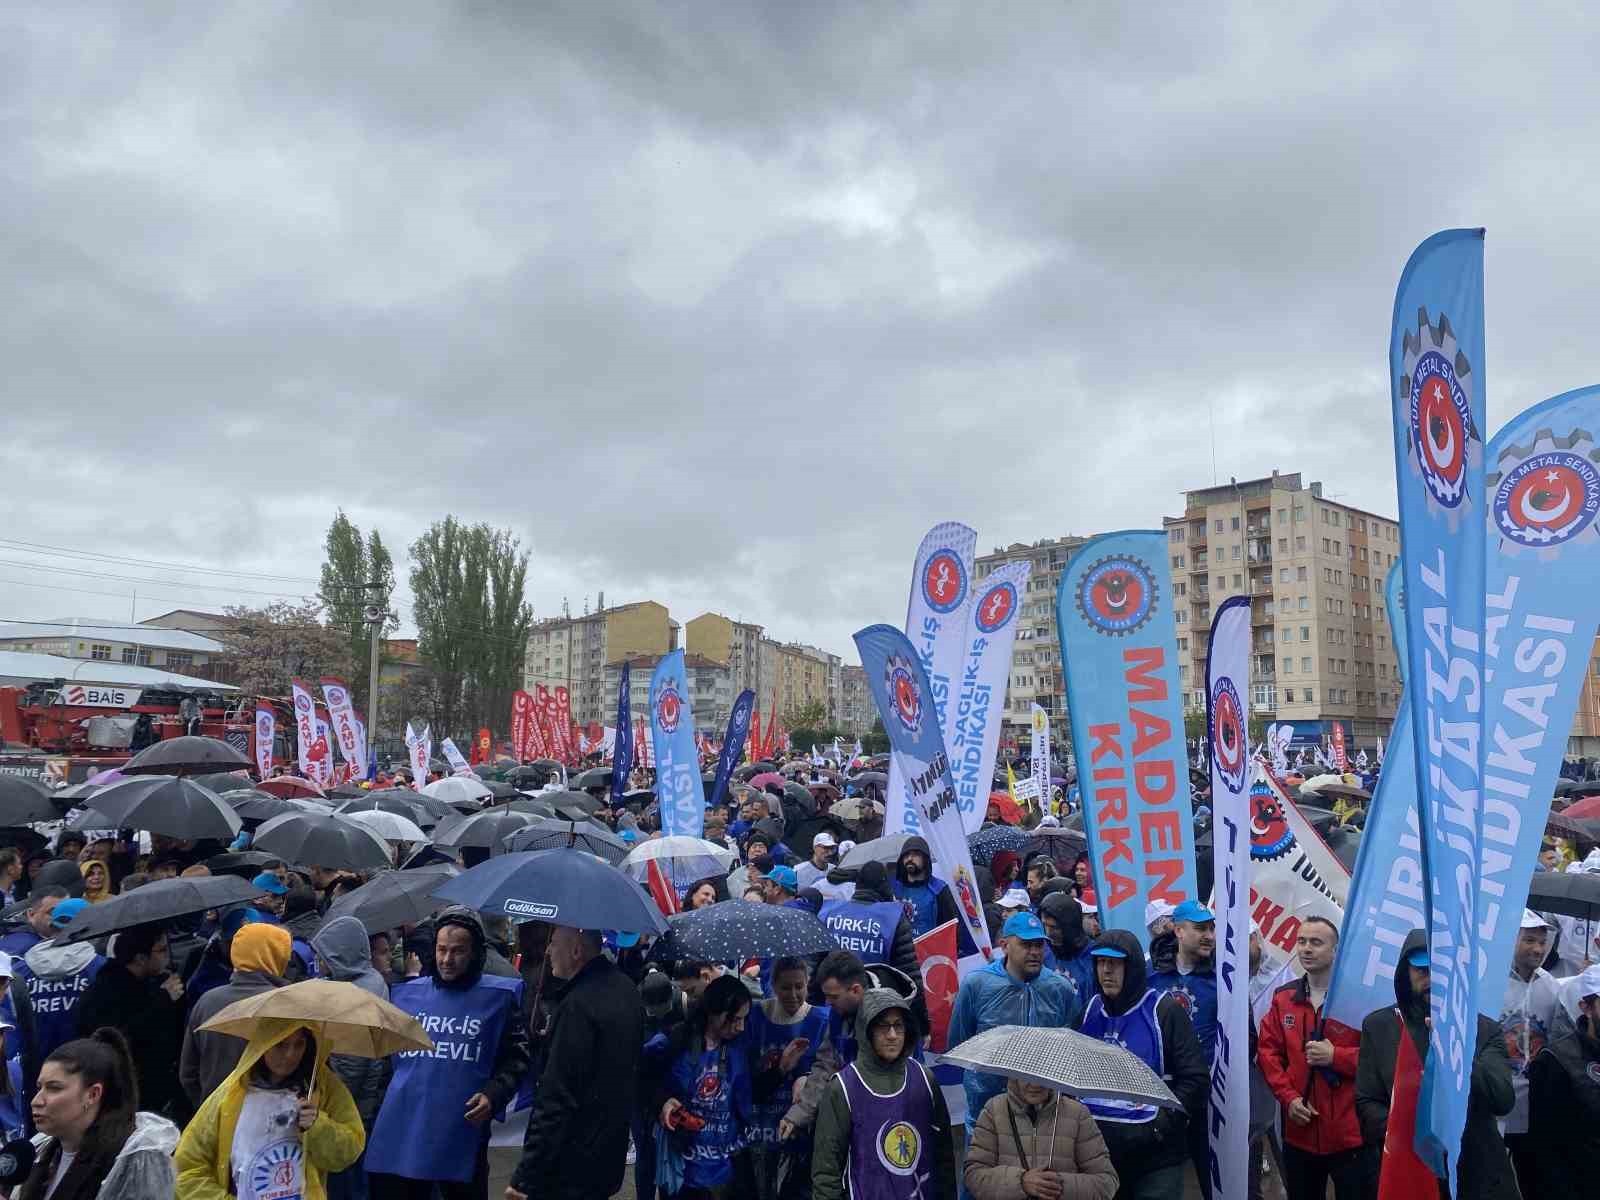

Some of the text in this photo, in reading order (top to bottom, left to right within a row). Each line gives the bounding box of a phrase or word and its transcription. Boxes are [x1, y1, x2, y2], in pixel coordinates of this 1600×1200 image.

[1416, 357, 1440, 384] METAL
[1518, 455, 1561, 476] METAL
[1123, 646, 1187, 906] MADEN
[1087, 722, 1138, 910] KIRKA
[826, 913, 881, 939] TÜRK-İŞ
[833, 933, 884, 955] REVLİ
[27, 974, 90, 995] ÜRK-İŞ
[410, 1012, 482, 1040] ÜRK-İŞ
